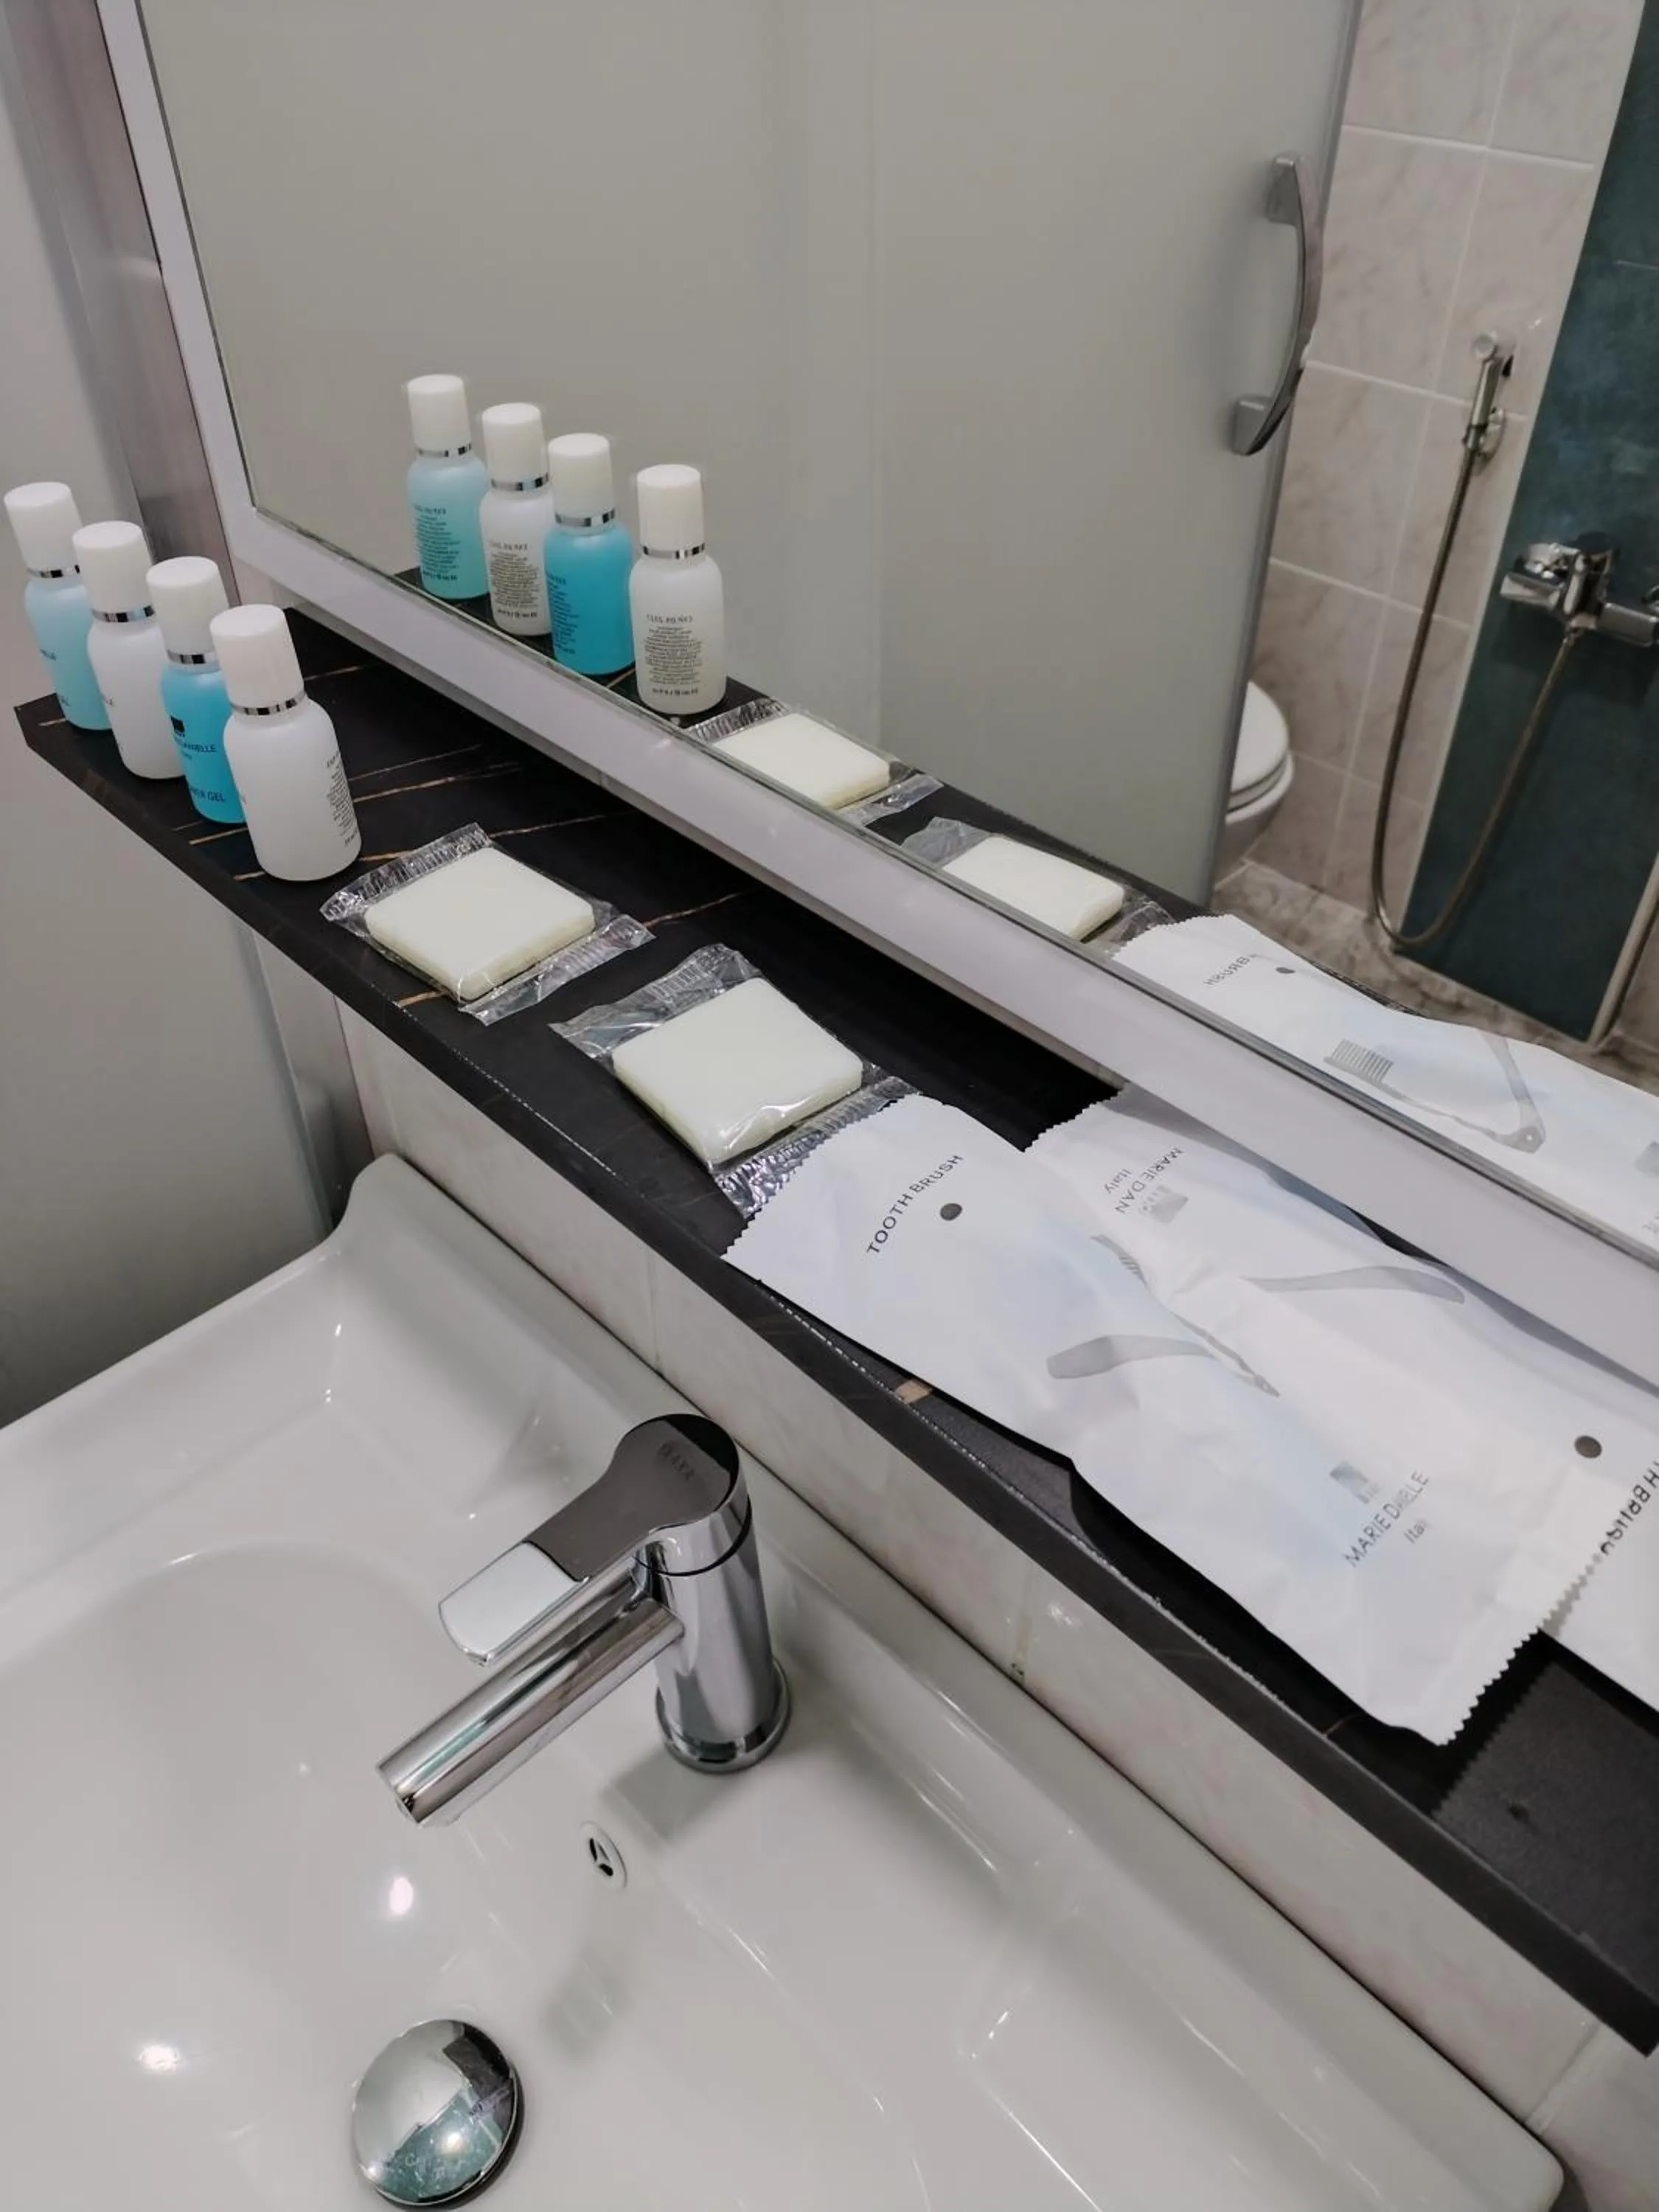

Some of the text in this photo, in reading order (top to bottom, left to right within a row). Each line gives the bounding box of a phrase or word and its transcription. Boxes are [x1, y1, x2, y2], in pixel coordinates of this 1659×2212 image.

[866, 1155, 964, 1254] TOOTH BRUSH
[1105, 1168, 1132, 1194] Italy
[1344, 1514, 1391, 1568] MARIE
